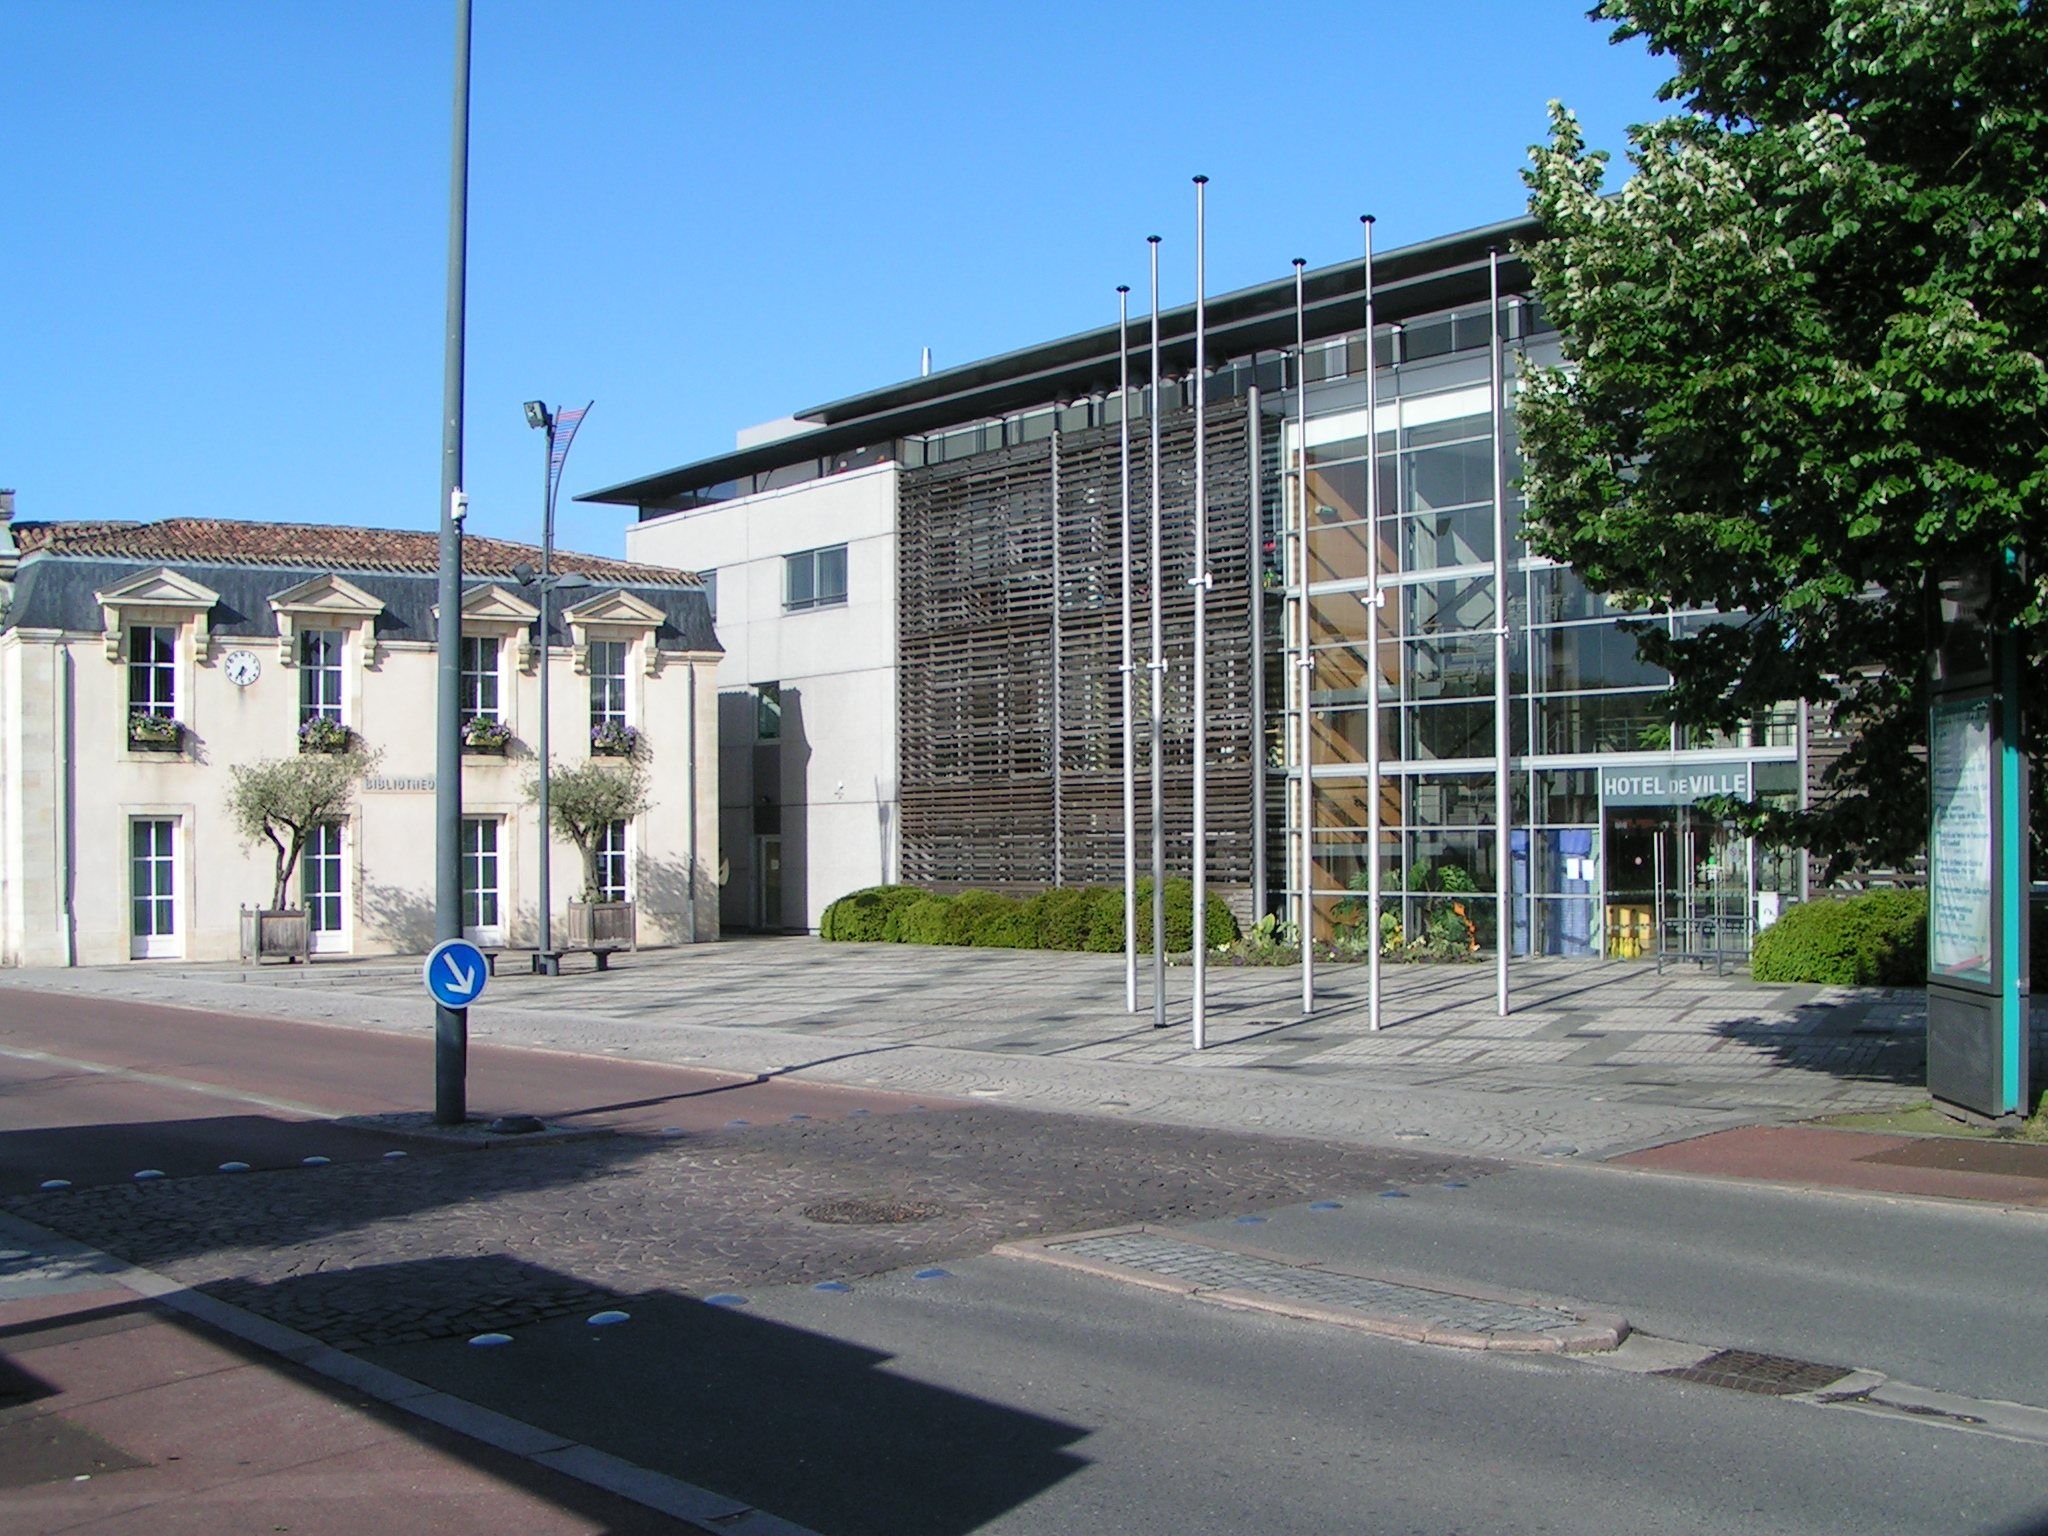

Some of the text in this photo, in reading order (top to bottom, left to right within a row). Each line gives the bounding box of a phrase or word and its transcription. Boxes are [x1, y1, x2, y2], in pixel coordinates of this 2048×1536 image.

[1604, 774, 1747, 796] HOTEL DE VILLE
